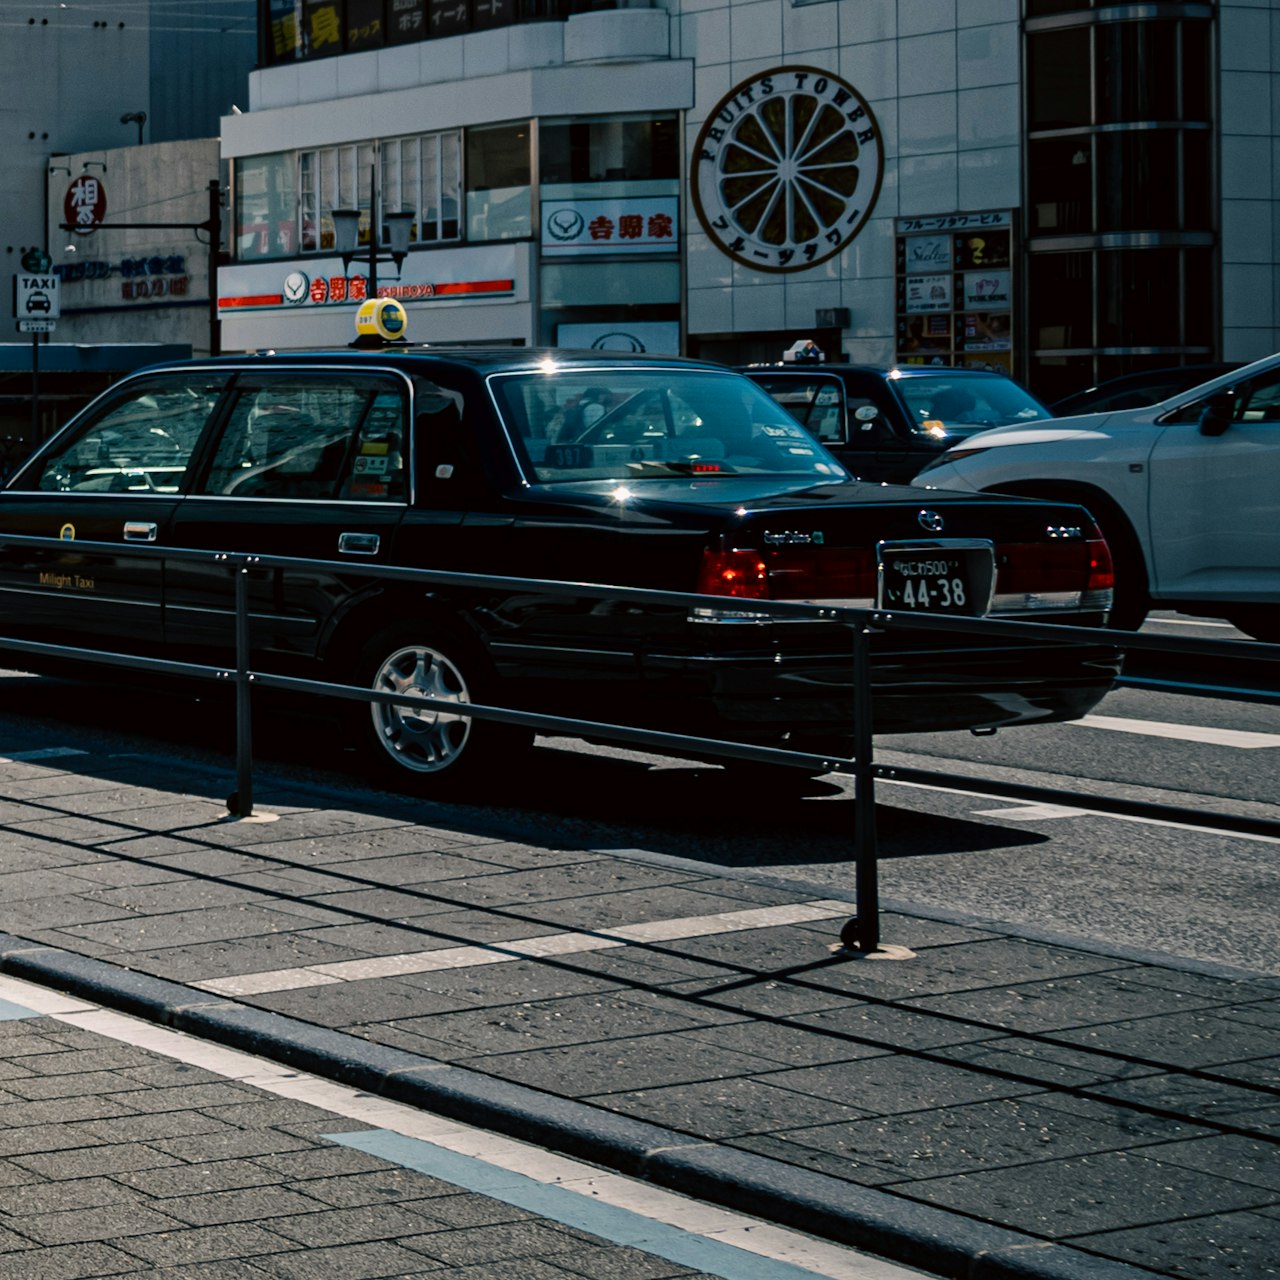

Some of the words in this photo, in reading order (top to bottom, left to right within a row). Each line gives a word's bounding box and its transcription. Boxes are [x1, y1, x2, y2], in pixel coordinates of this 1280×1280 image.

[700, 78, 774, 162] FRUITS
[795, 74, 874, 145] TOWER
[588, 212, 674, 241] 吉野家
[904, 213, 1003, 231] フルーツタワービル
[713, 209, 860, 265] フルーツタワー
[22, 278, 56, 289] TAXI
[309, 274, 368, 304] 吉野家
[40, 572, 72, 589] Milight
[75, 574, 95, 590] Taxi
[926, 560, 949, 576] 500
[903, 578, 967, 608] 44-38
